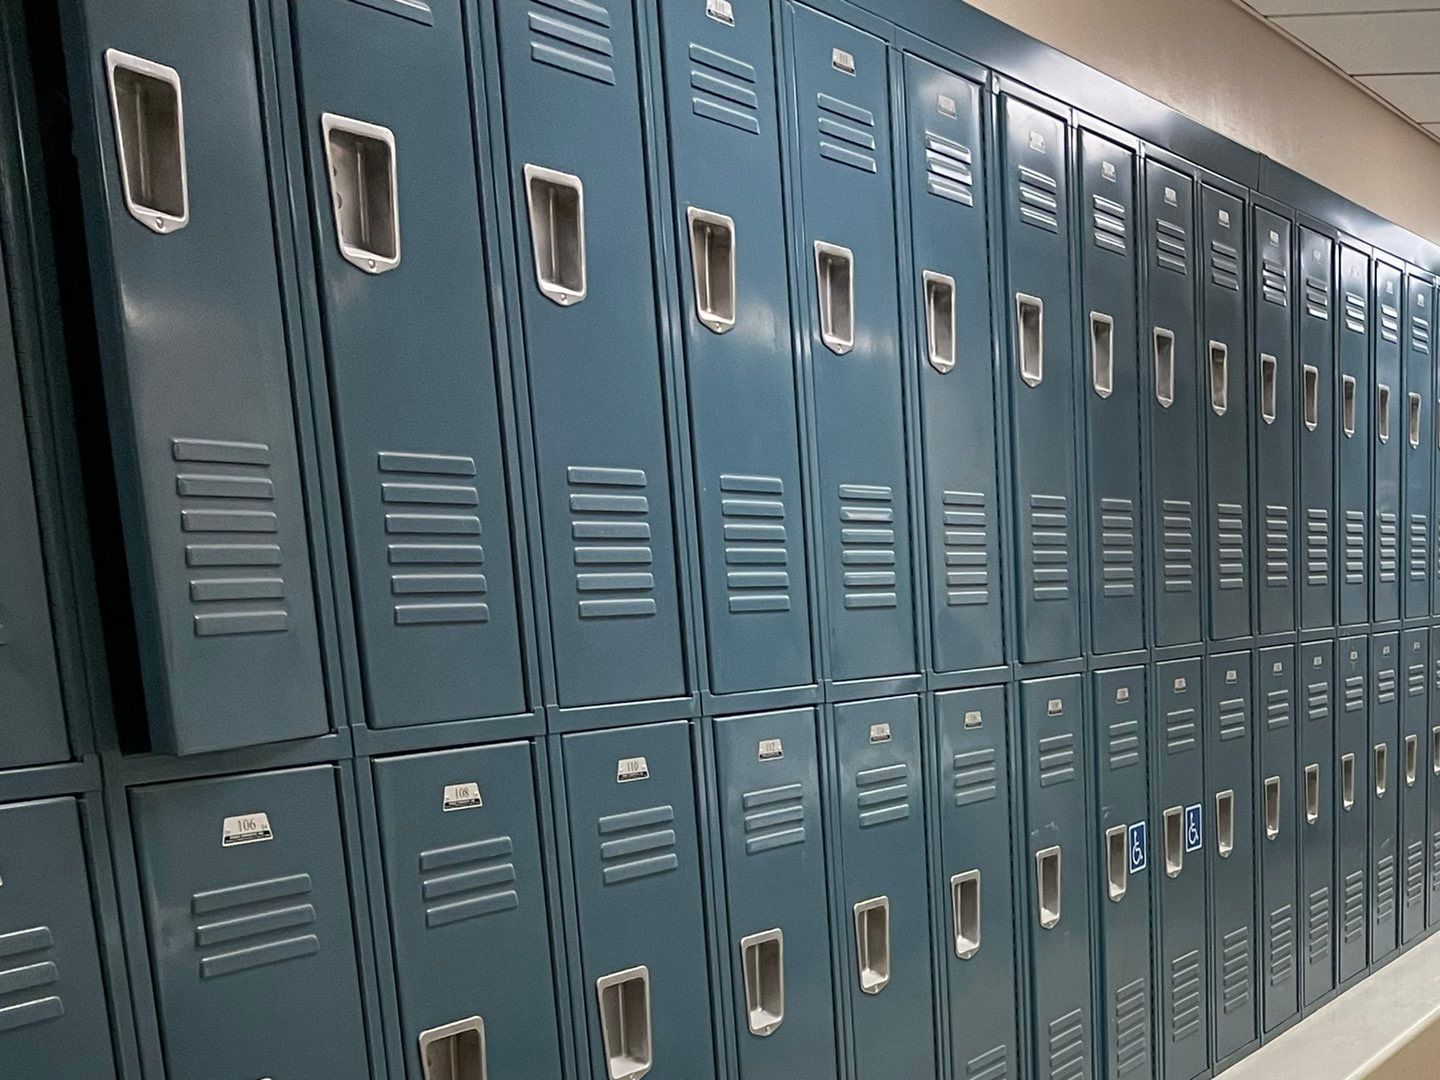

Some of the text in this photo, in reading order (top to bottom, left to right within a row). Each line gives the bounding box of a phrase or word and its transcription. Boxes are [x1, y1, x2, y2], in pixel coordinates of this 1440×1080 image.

[627, 761, 639, 772] 110
[455, 787, 470, 799] 108
[237, 819, 257, 832] 106
